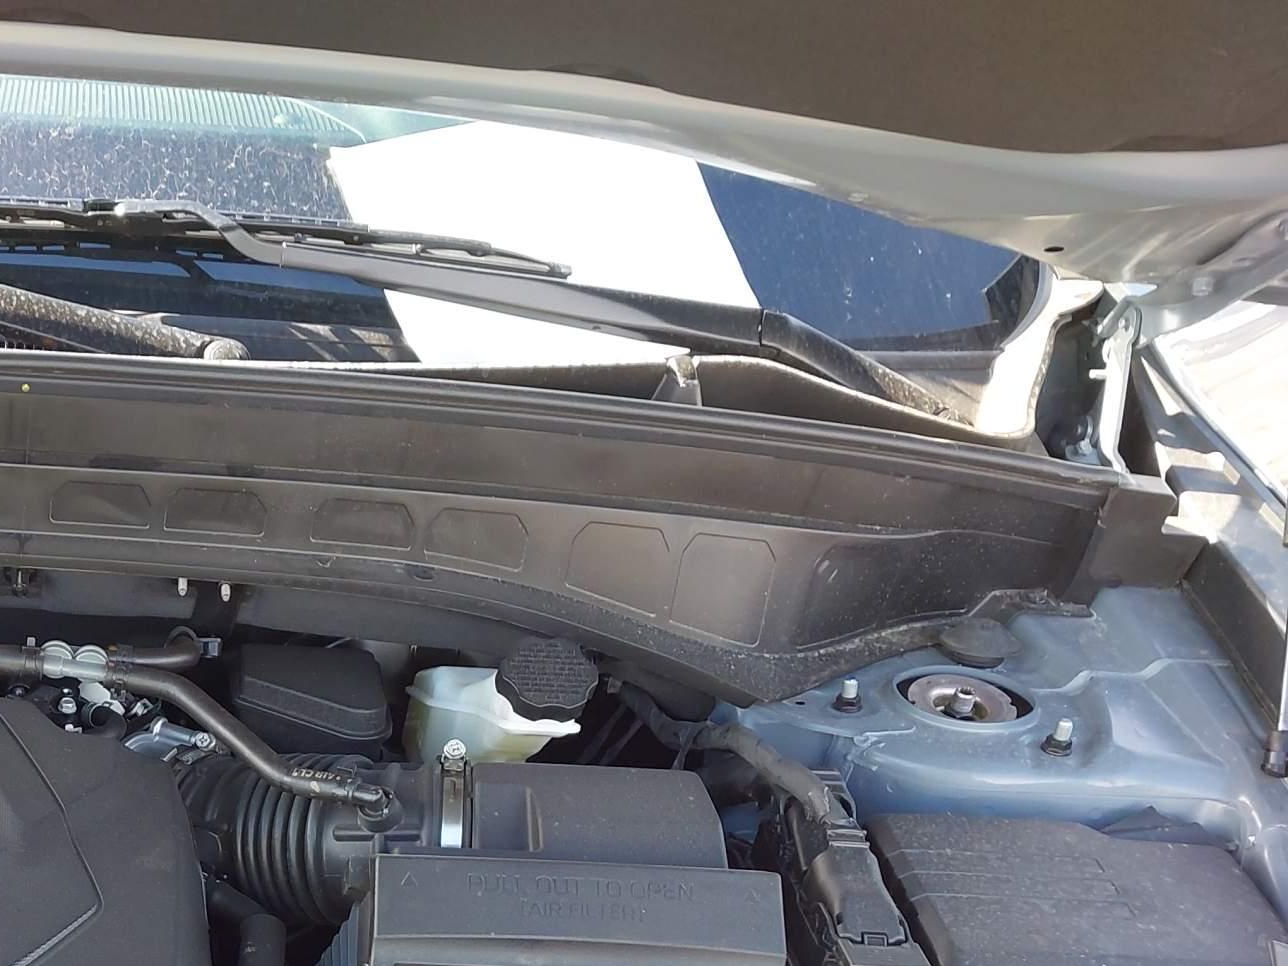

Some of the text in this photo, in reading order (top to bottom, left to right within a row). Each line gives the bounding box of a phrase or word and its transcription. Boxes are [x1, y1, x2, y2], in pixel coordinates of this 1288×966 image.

[466, 872, 694, 902] PULL OUT TO OPEN
